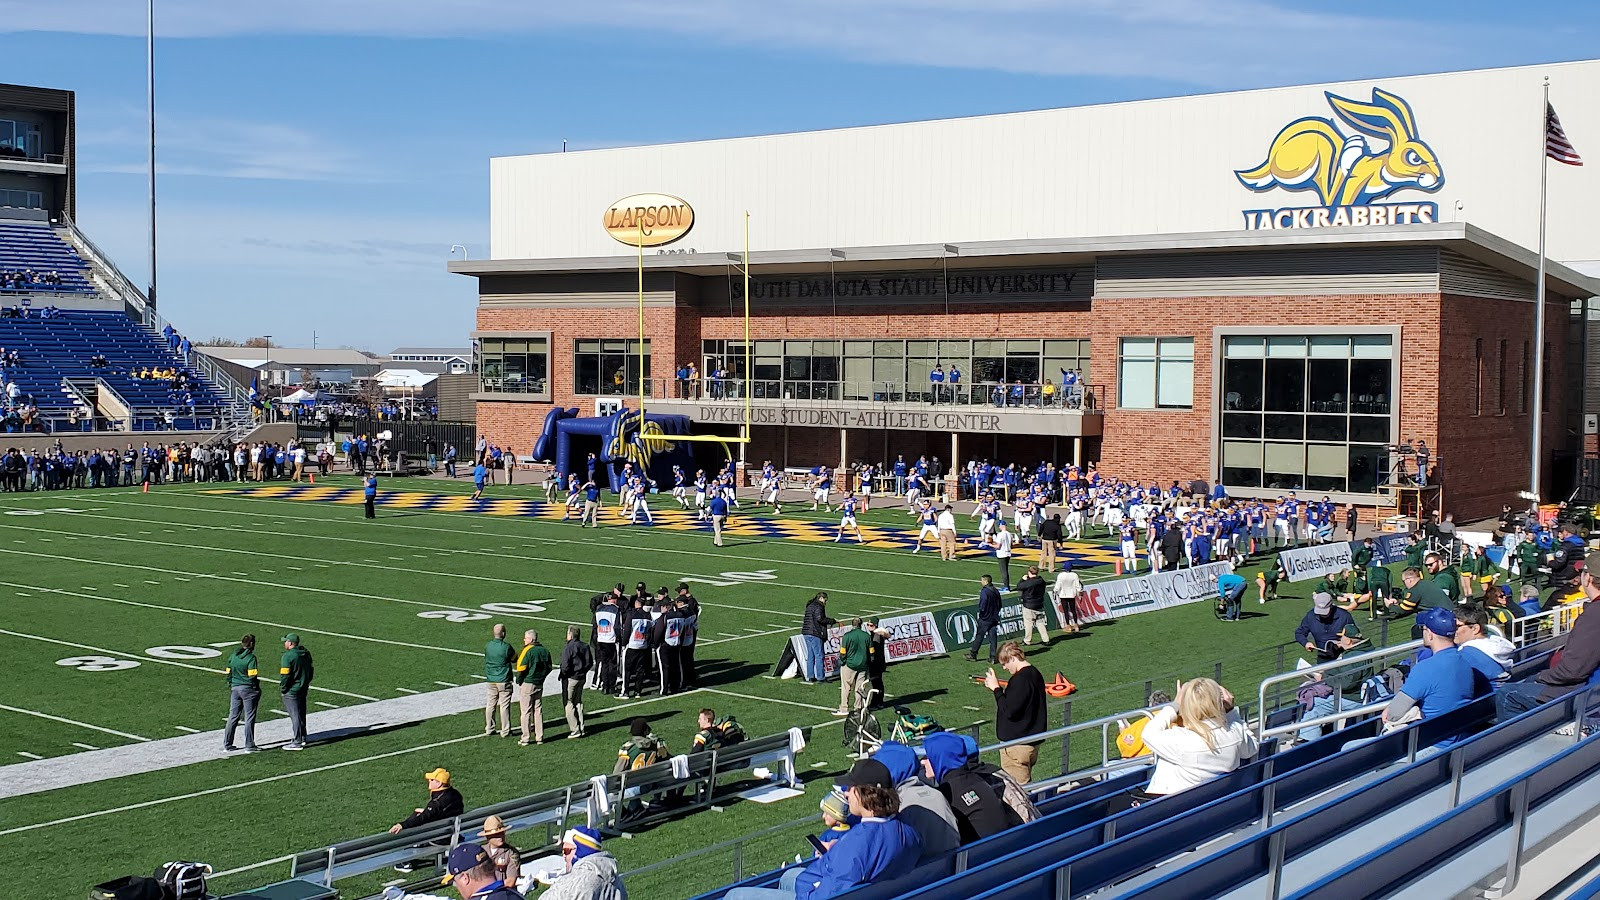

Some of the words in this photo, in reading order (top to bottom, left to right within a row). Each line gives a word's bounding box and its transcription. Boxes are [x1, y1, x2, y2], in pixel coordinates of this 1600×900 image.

[607, 204, 684, 236] LARSON
[1244, 204, 1434, 230] JACKRABBITS
[946, 272, 1077, 294] UNIVERSITY
[700, 406, 777, 423] DYKHOUSE
[781, 408, 929, 429] STUDENT-ATHLETE
[934, 413, 1001, 430] CENTER
[1110, 590, 1152, 605] AUTHORITY
[885, 621, 920, 641] CASE
[55, 645, 223, 672] 30
[887, 641, 908, 659] RED
[908, 636, 935, 655] ZONE
